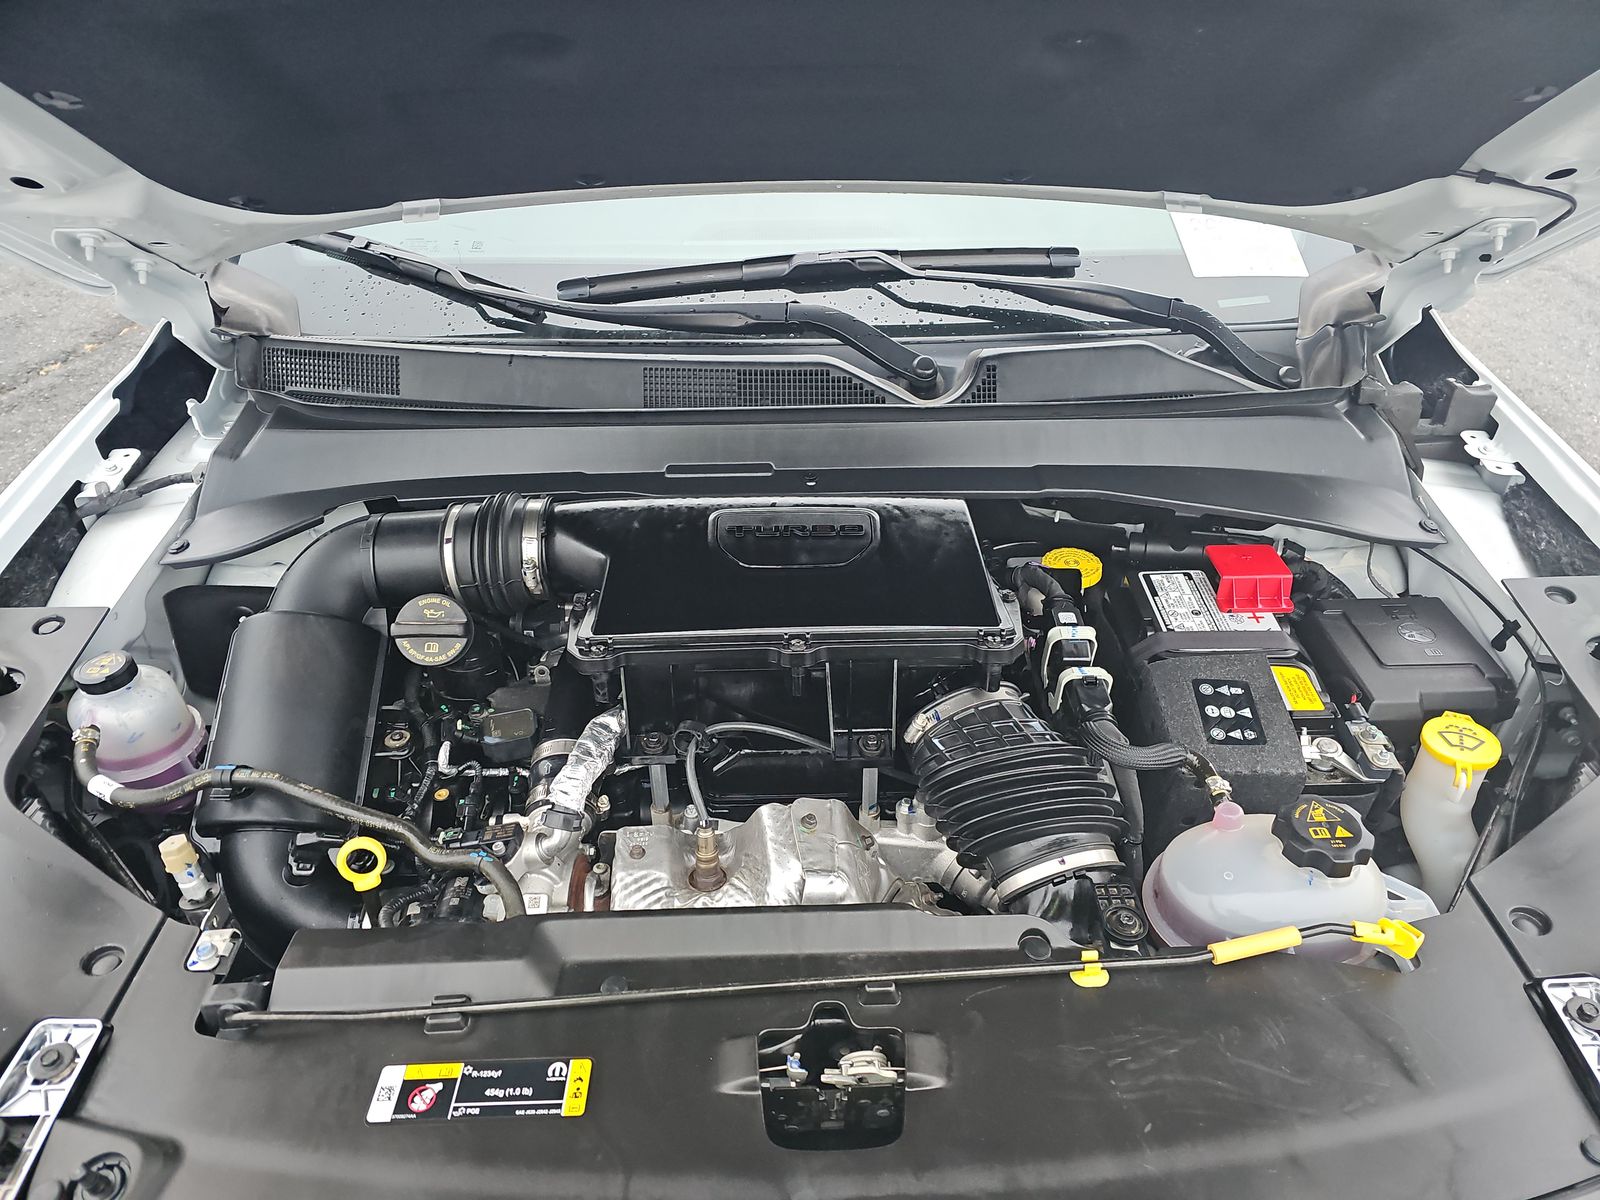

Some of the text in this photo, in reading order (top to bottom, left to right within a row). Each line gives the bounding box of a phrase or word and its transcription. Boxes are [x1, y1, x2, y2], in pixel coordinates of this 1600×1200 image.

[726, 524, 865, 538] TURBO
[418, 597, 451, 608] ENGINE OIL
[484, 1087, 505, 1098] 454g
